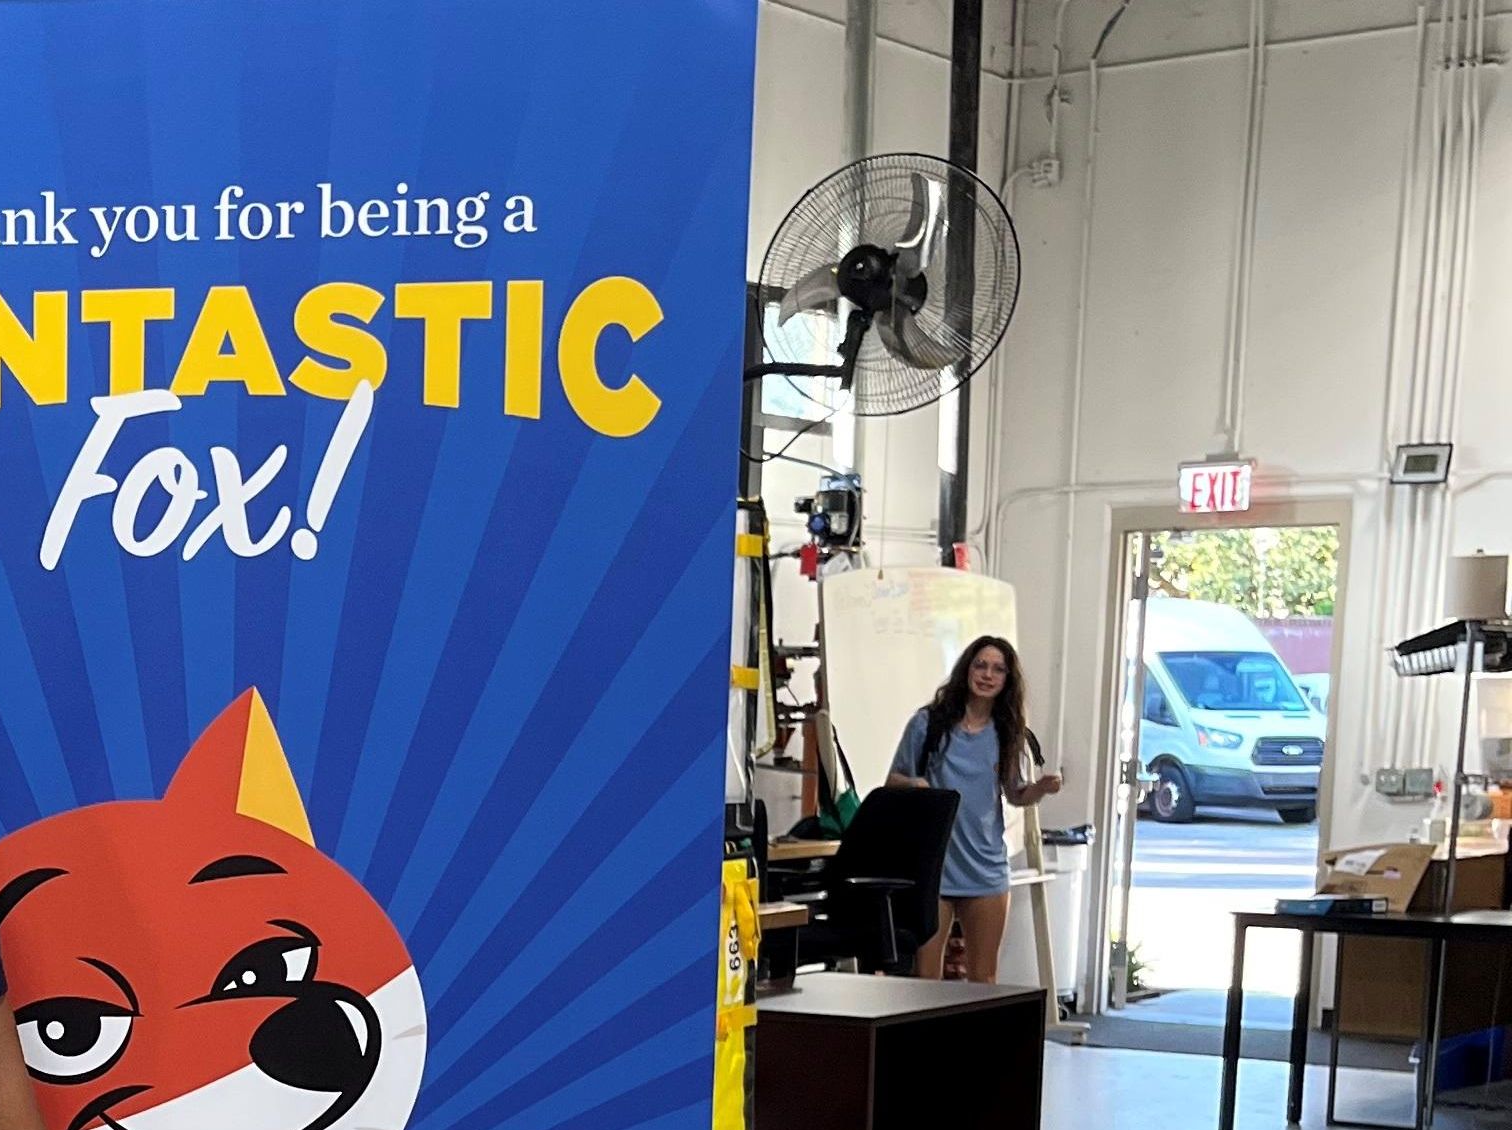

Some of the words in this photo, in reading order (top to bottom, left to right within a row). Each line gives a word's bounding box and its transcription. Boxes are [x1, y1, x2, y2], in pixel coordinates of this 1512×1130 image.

[89, 206, 197, 258] you
[214, 185, 306, 241] for
[319, 182, 490, 249] being
[502, 192, 537, 233] a
[39, 380, 373, 571] Fox!
[1191, 471, 1241, 510] EXIT
